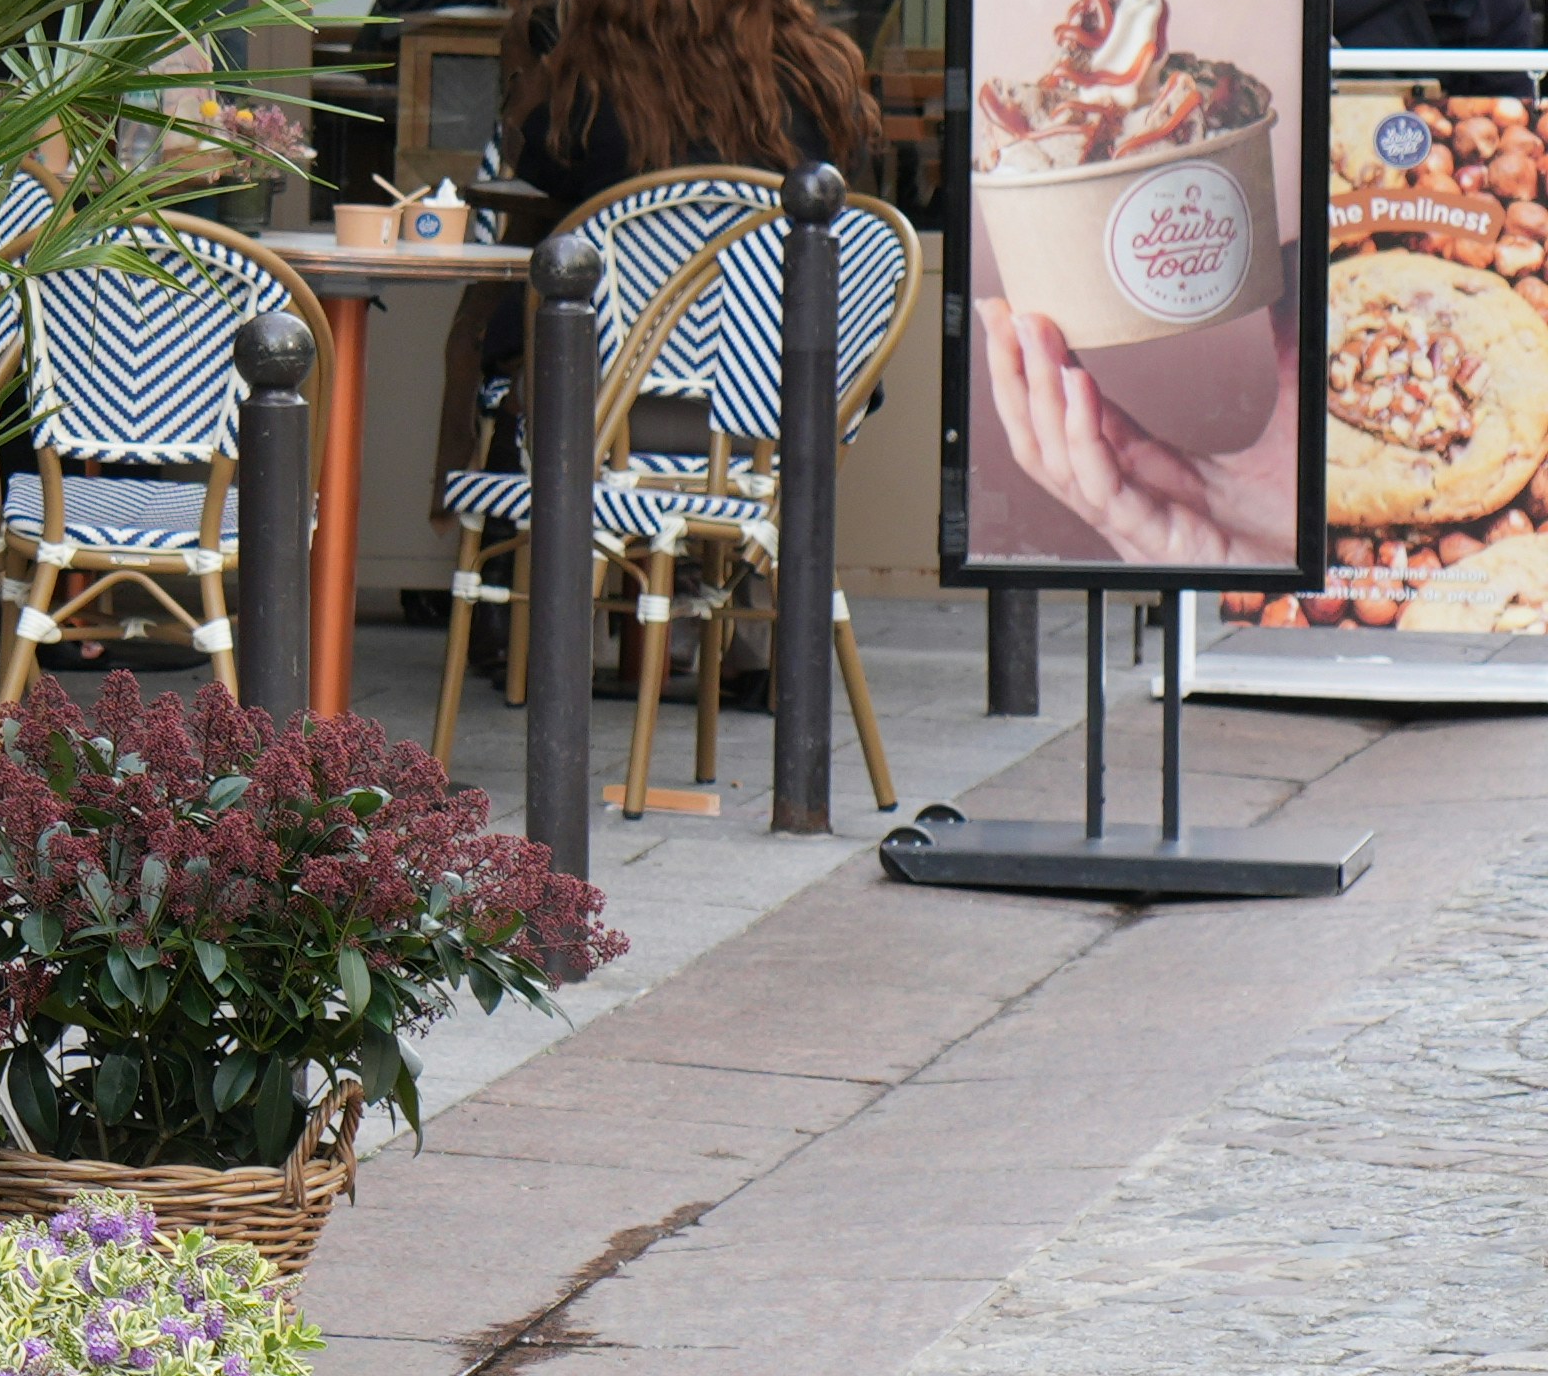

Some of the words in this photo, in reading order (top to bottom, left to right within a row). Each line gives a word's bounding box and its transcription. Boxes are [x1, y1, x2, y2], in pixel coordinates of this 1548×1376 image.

[1133, 207, 1237, 249] Laura
[1329, 202, 1363, 228] he
[1371, 197, 1492, 236] Pralinest
